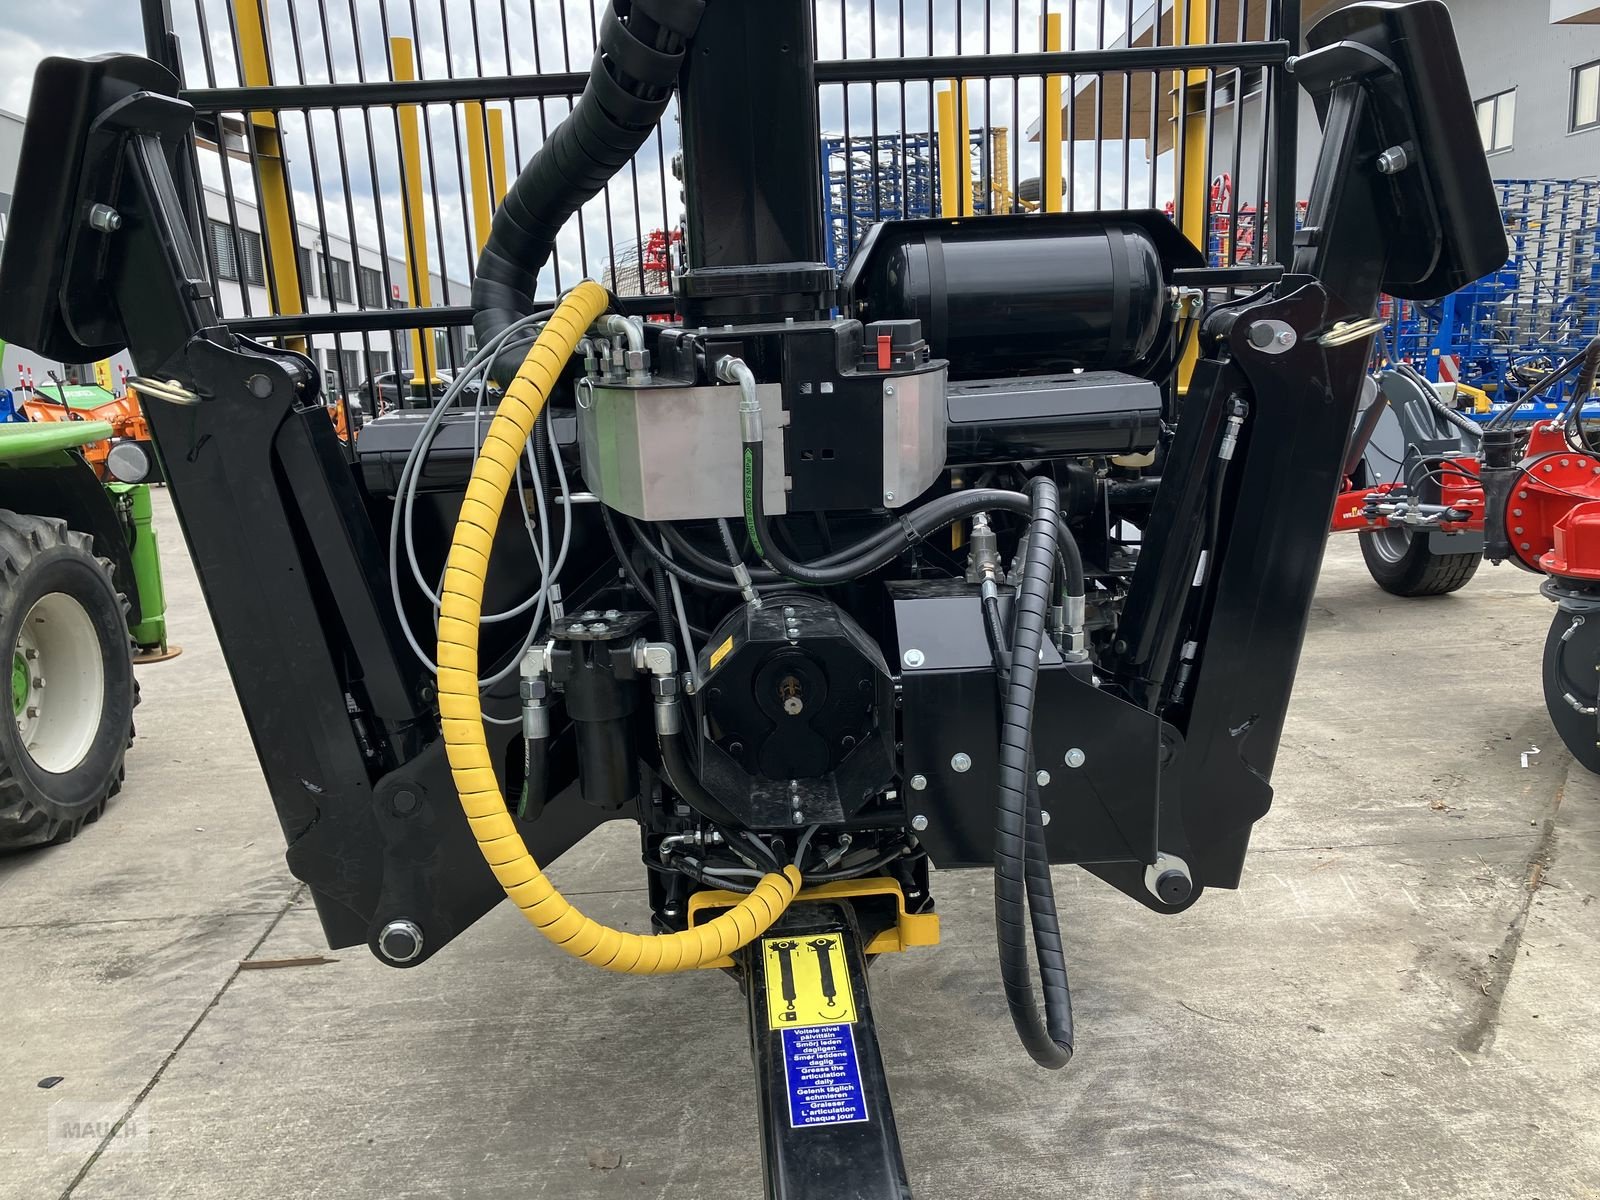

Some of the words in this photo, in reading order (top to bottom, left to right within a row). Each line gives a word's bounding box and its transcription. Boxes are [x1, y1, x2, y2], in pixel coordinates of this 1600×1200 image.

[800, 1033, 836, 1041] päivittäin
[803, 1045, 836, 1053] dagligen
[801, 1066, 830, 1074] Grease
[801, 1071, 846, 1080] articulation
[797, 1087, 825, 1095] Gelenk
[826, 1084, 855, 1093] täglich
[805, 1092, 848, 1101] schmieren
[810, 1100, 845, 1109] Graisser
[805, 1115, 836, 1123] chaque
[837, 1113, 855, 1121] jour
